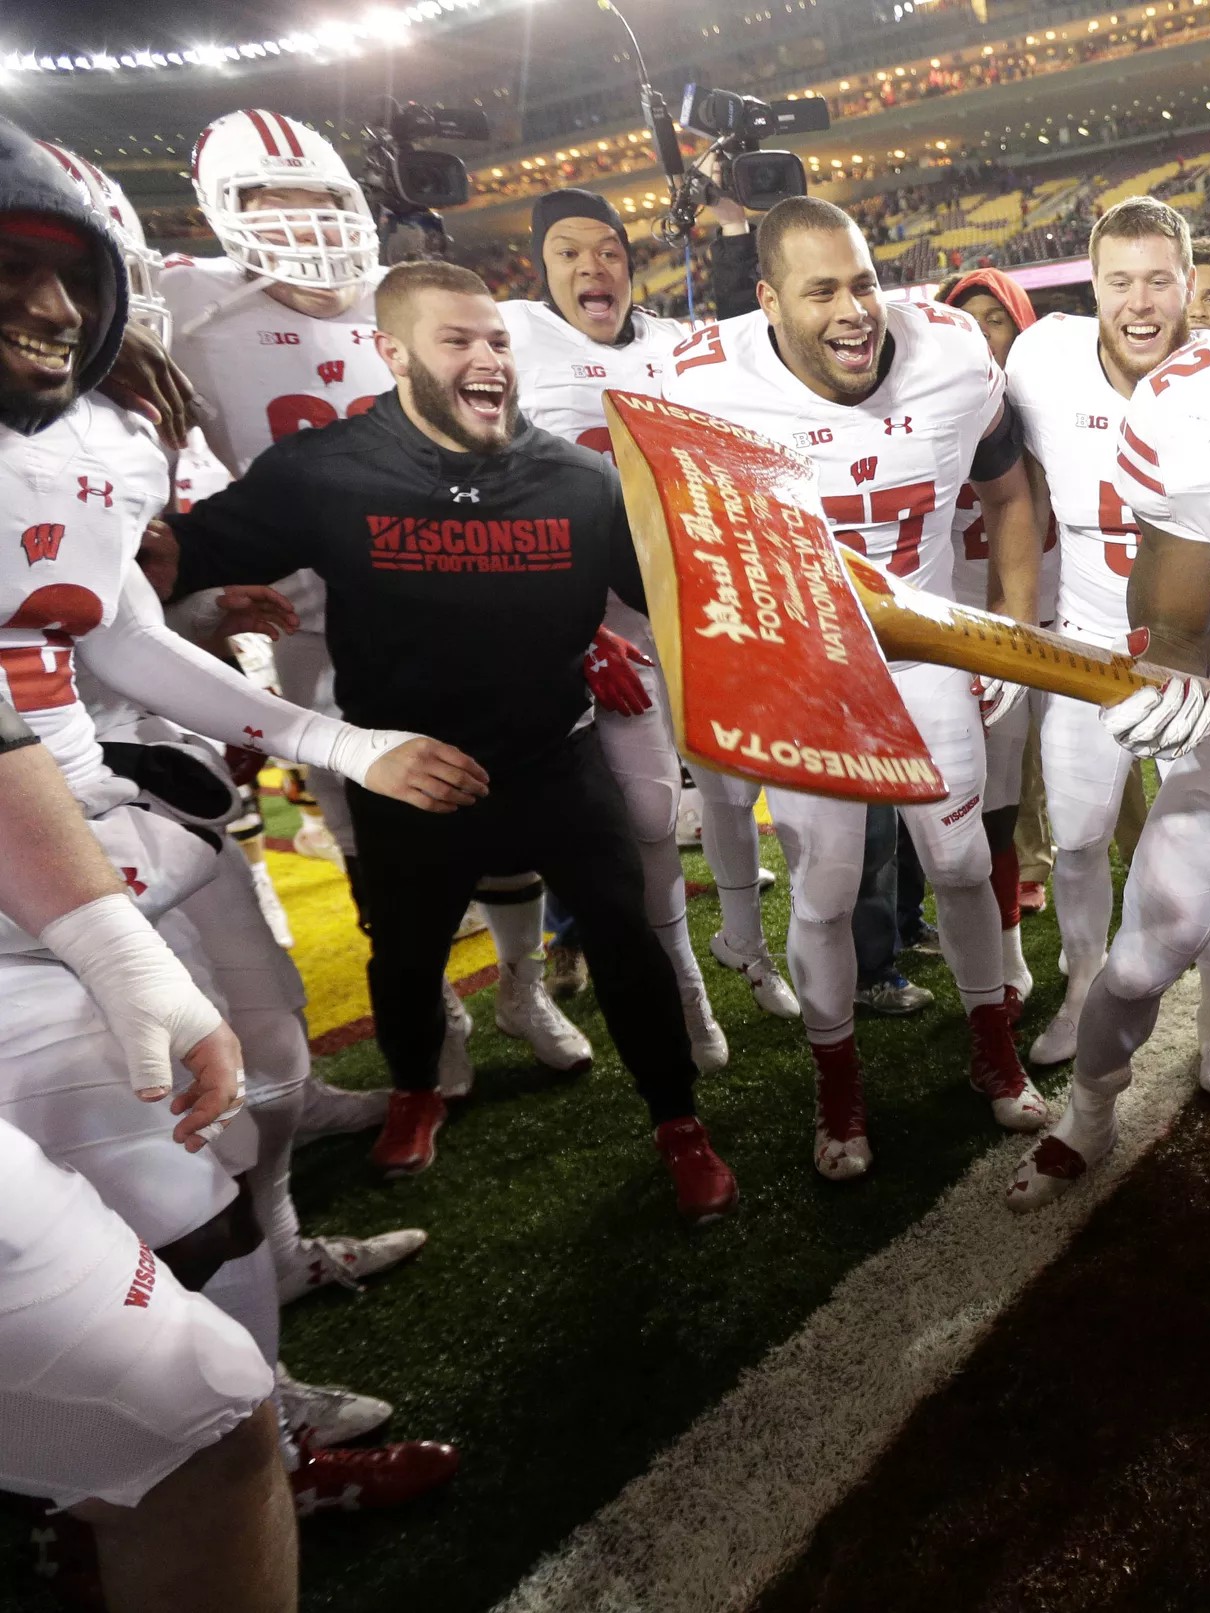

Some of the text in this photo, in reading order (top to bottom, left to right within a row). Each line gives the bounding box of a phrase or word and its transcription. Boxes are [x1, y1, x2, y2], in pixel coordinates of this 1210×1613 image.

[619, 393, 814, 467] WISCON
[850, 456, 878, 487] W
[21, 522, 66, 567] W
[366, 515, 572, 555] WISCONSIN
[706, 459, 785, 646] FOOTBALL TROPHY
[424, 554, 527, 573] FOOTBALL
[694, 549, 759, 645] Paul
[800, 557, 850, 666] NATIONAL
[710, 719, 938, 784] MINNESOTA
[941, 793, 980, 827] WISCONSIN
